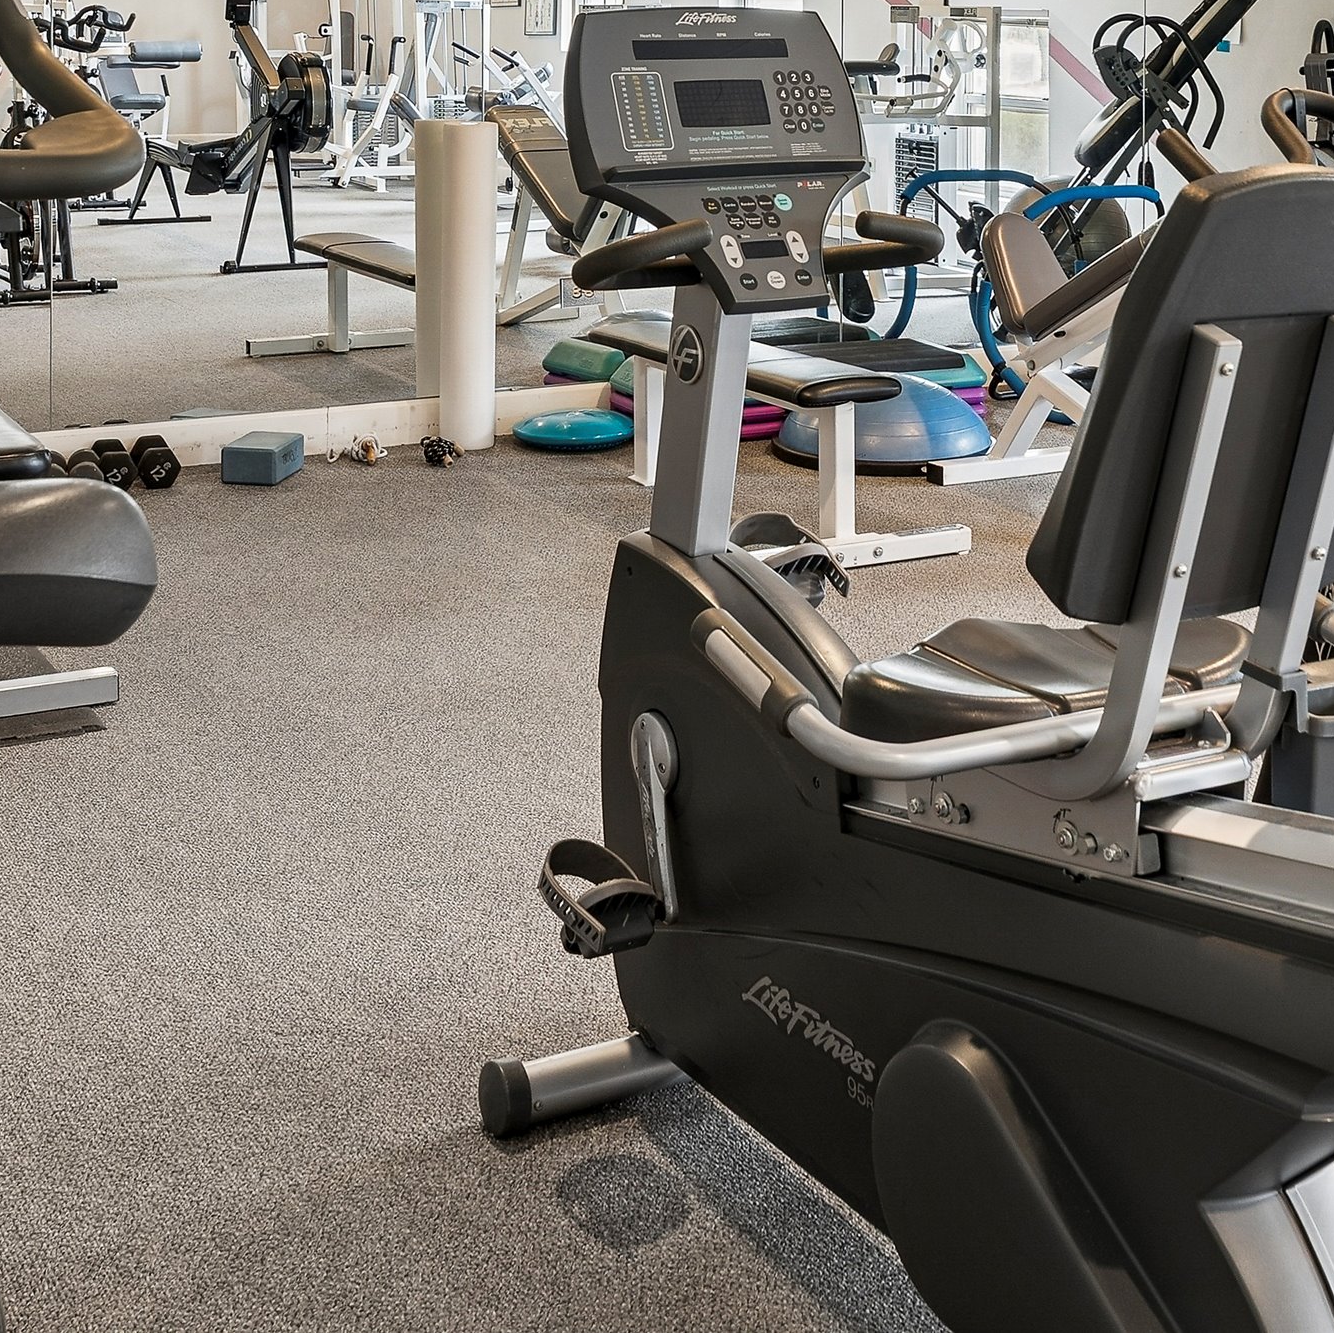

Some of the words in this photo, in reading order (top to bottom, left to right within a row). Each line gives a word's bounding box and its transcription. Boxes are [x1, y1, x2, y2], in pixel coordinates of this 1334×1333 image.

[675, 12, 737, 26] LifeFitness
[777, 74, 782, 82] 1
[791, 73, 797, 81] 2
[805, 73, 811, 81] 3
[780, 90, 786, 98] 4
[794, 89, 800, 97] 5
[808, 89, 814, 97] 6
[783, 106, 789, 114] 7
[797, 106, 804, 114] 8
[811, 105, 818, 113] 9
[801, 122, 807, 130] 0
[150, 464, 166, 482] 12
[741, 976, 875, 1082] LifeFitness
